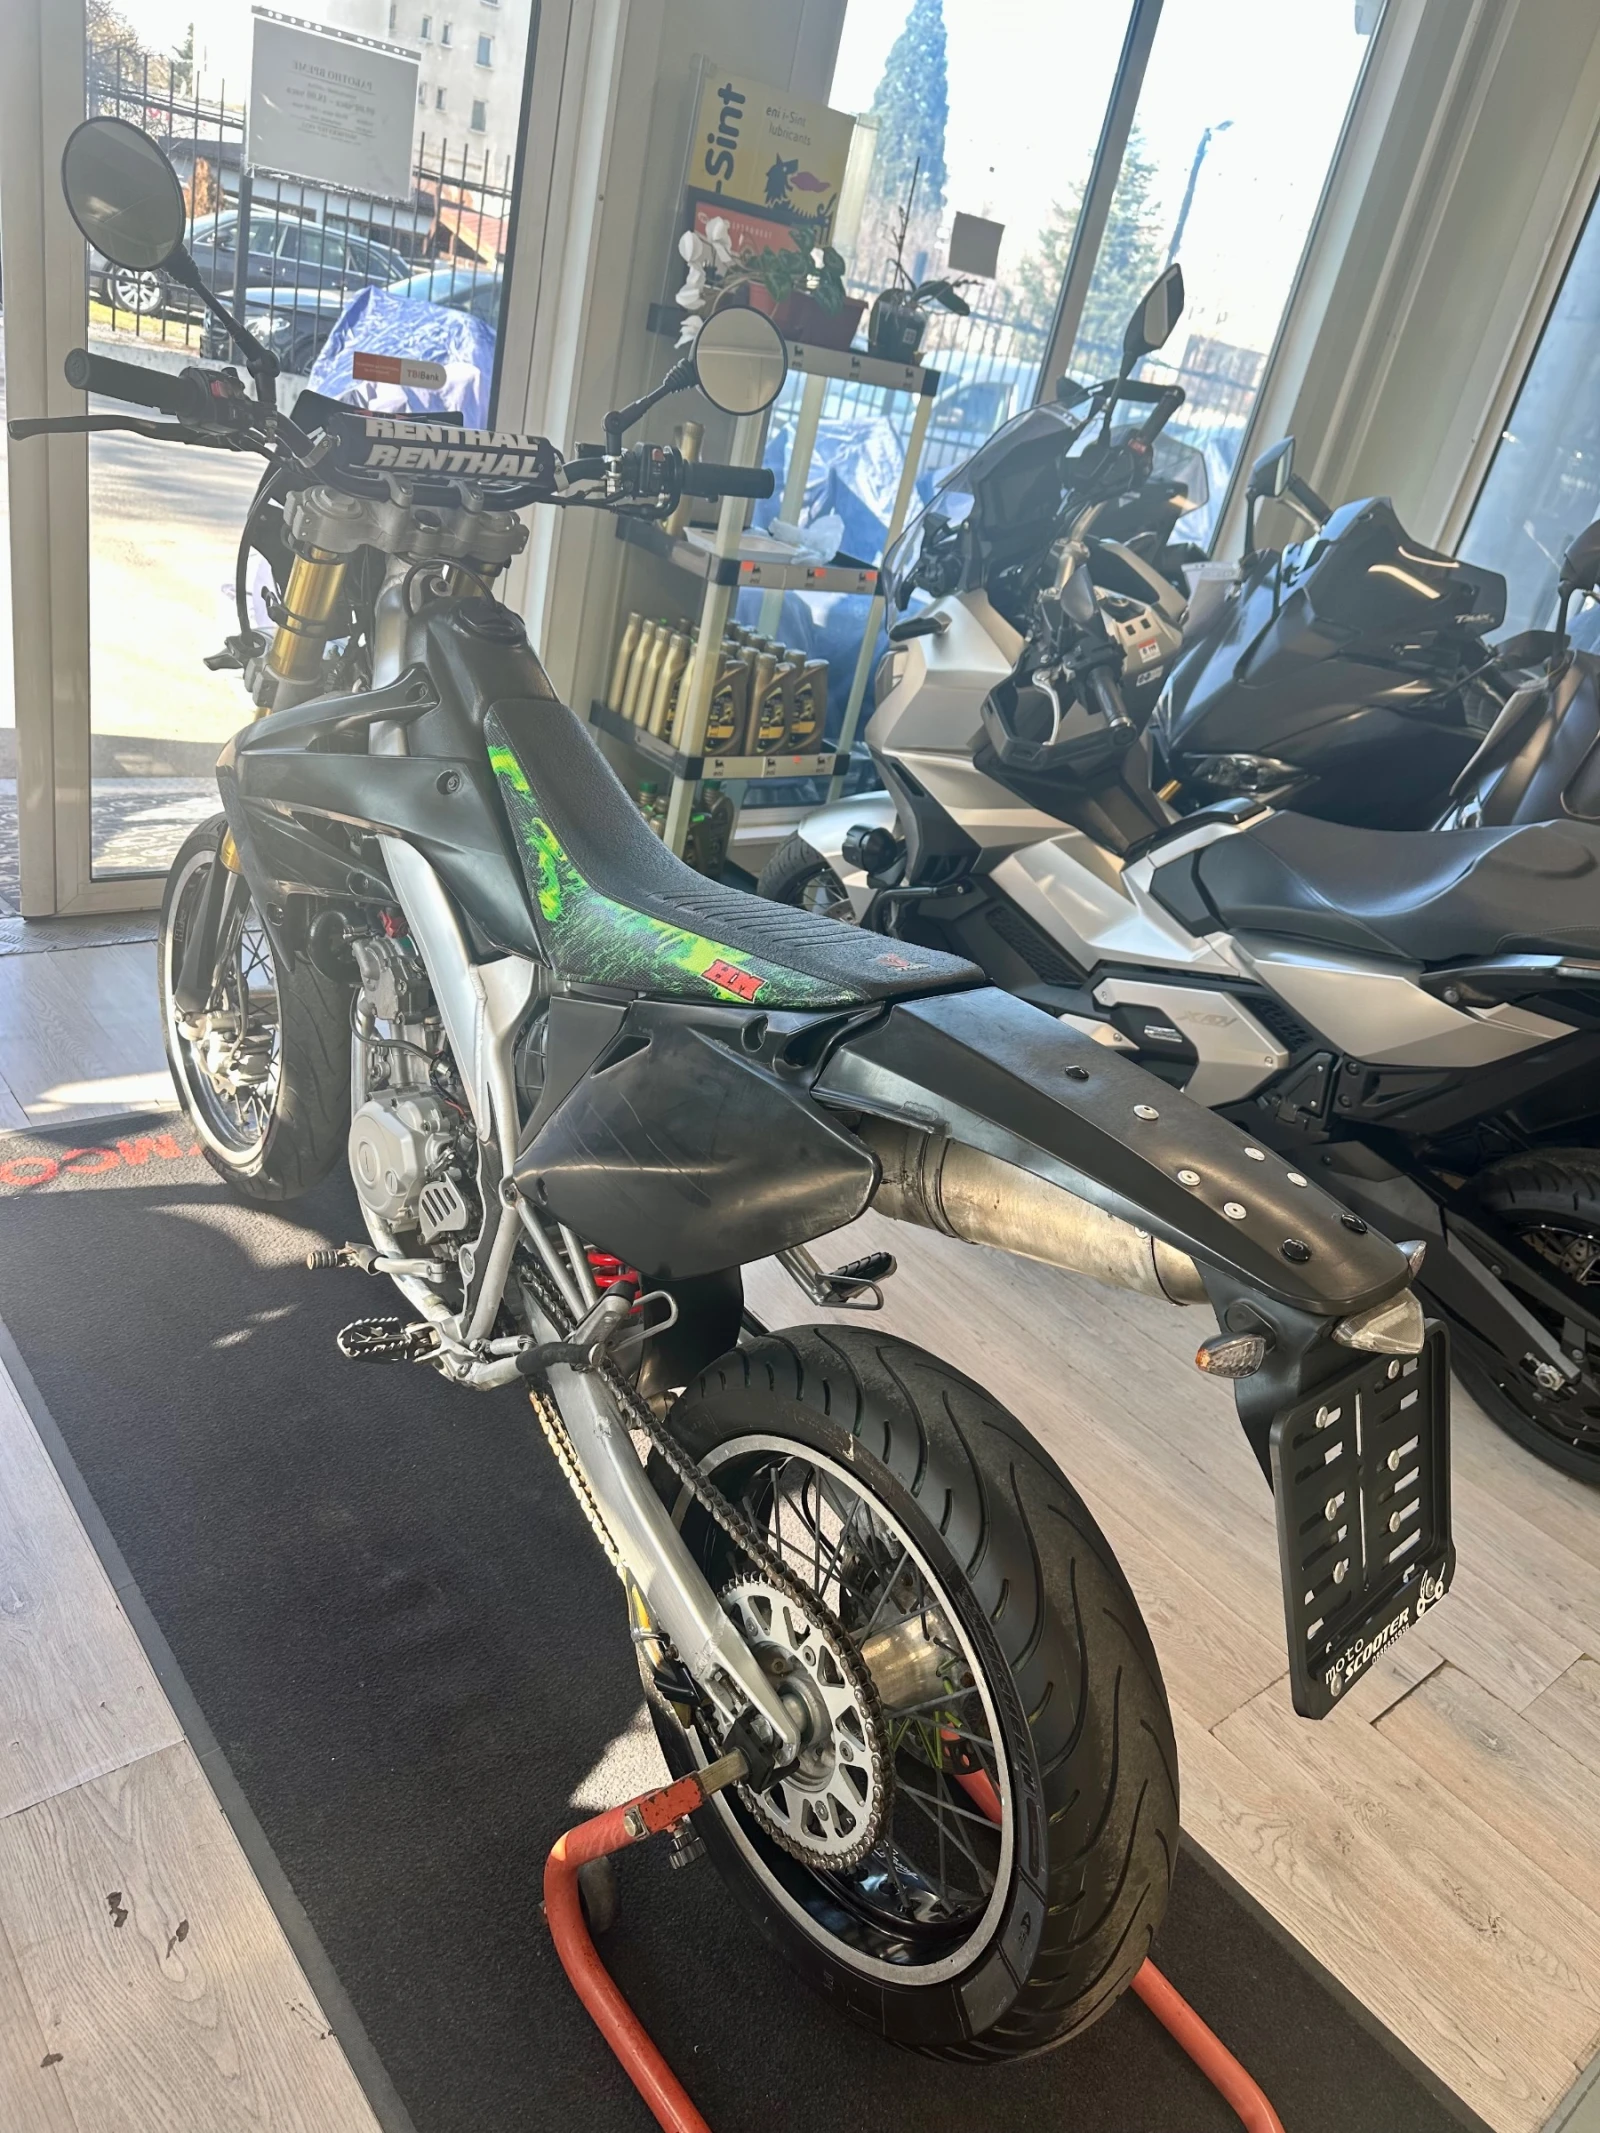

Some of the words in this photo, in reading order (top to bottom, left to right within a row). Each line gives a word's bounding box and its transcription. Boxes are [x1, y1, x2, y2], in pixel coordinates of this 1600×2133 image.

[766, 106, 781, 119] eni
[768, 120, 811, 146] lubricants
[365, 418, 539, 452] RENTHAL
[364, 443, 540, 478] RENTHAL
[1344, 1606, 1410, 1684] SCOOTER
